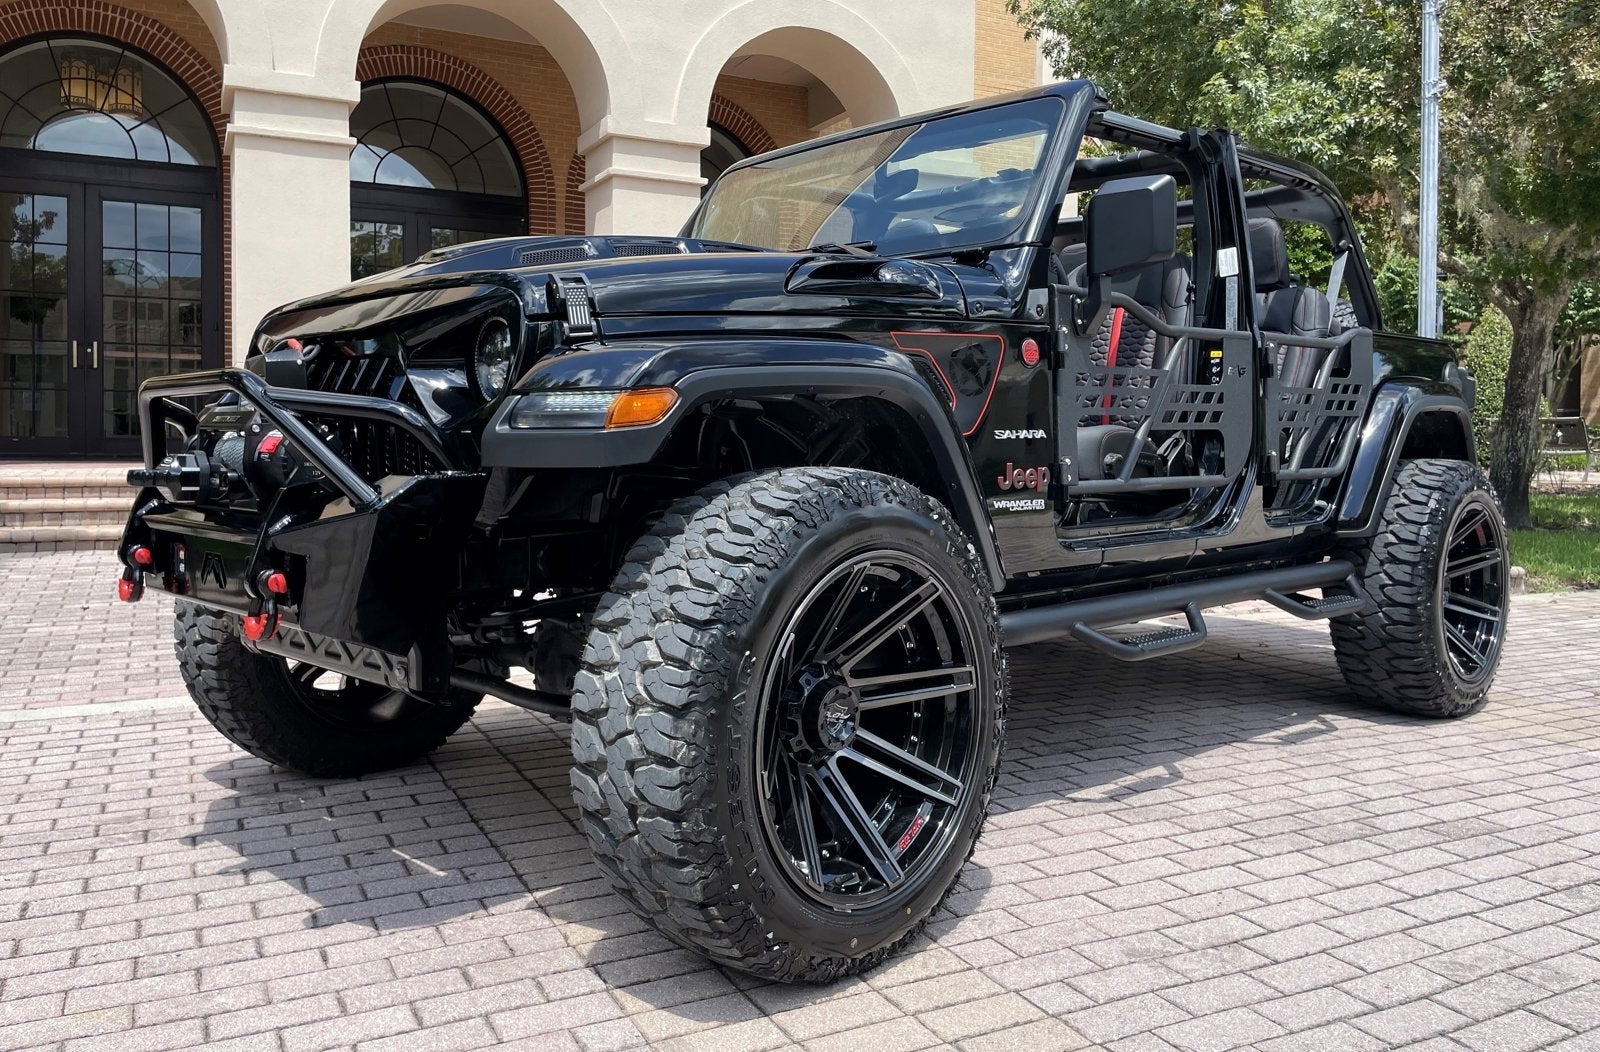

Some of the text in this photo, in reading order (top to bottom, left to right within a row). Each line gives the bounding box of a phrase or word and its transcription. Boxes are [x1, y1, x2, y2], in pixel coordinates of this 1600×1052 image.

[993, 429, 1047, 440] SAHARA
[996, 462, 1051, 492] Jeep
[993, 498, 1045, 509] WRANGLER
